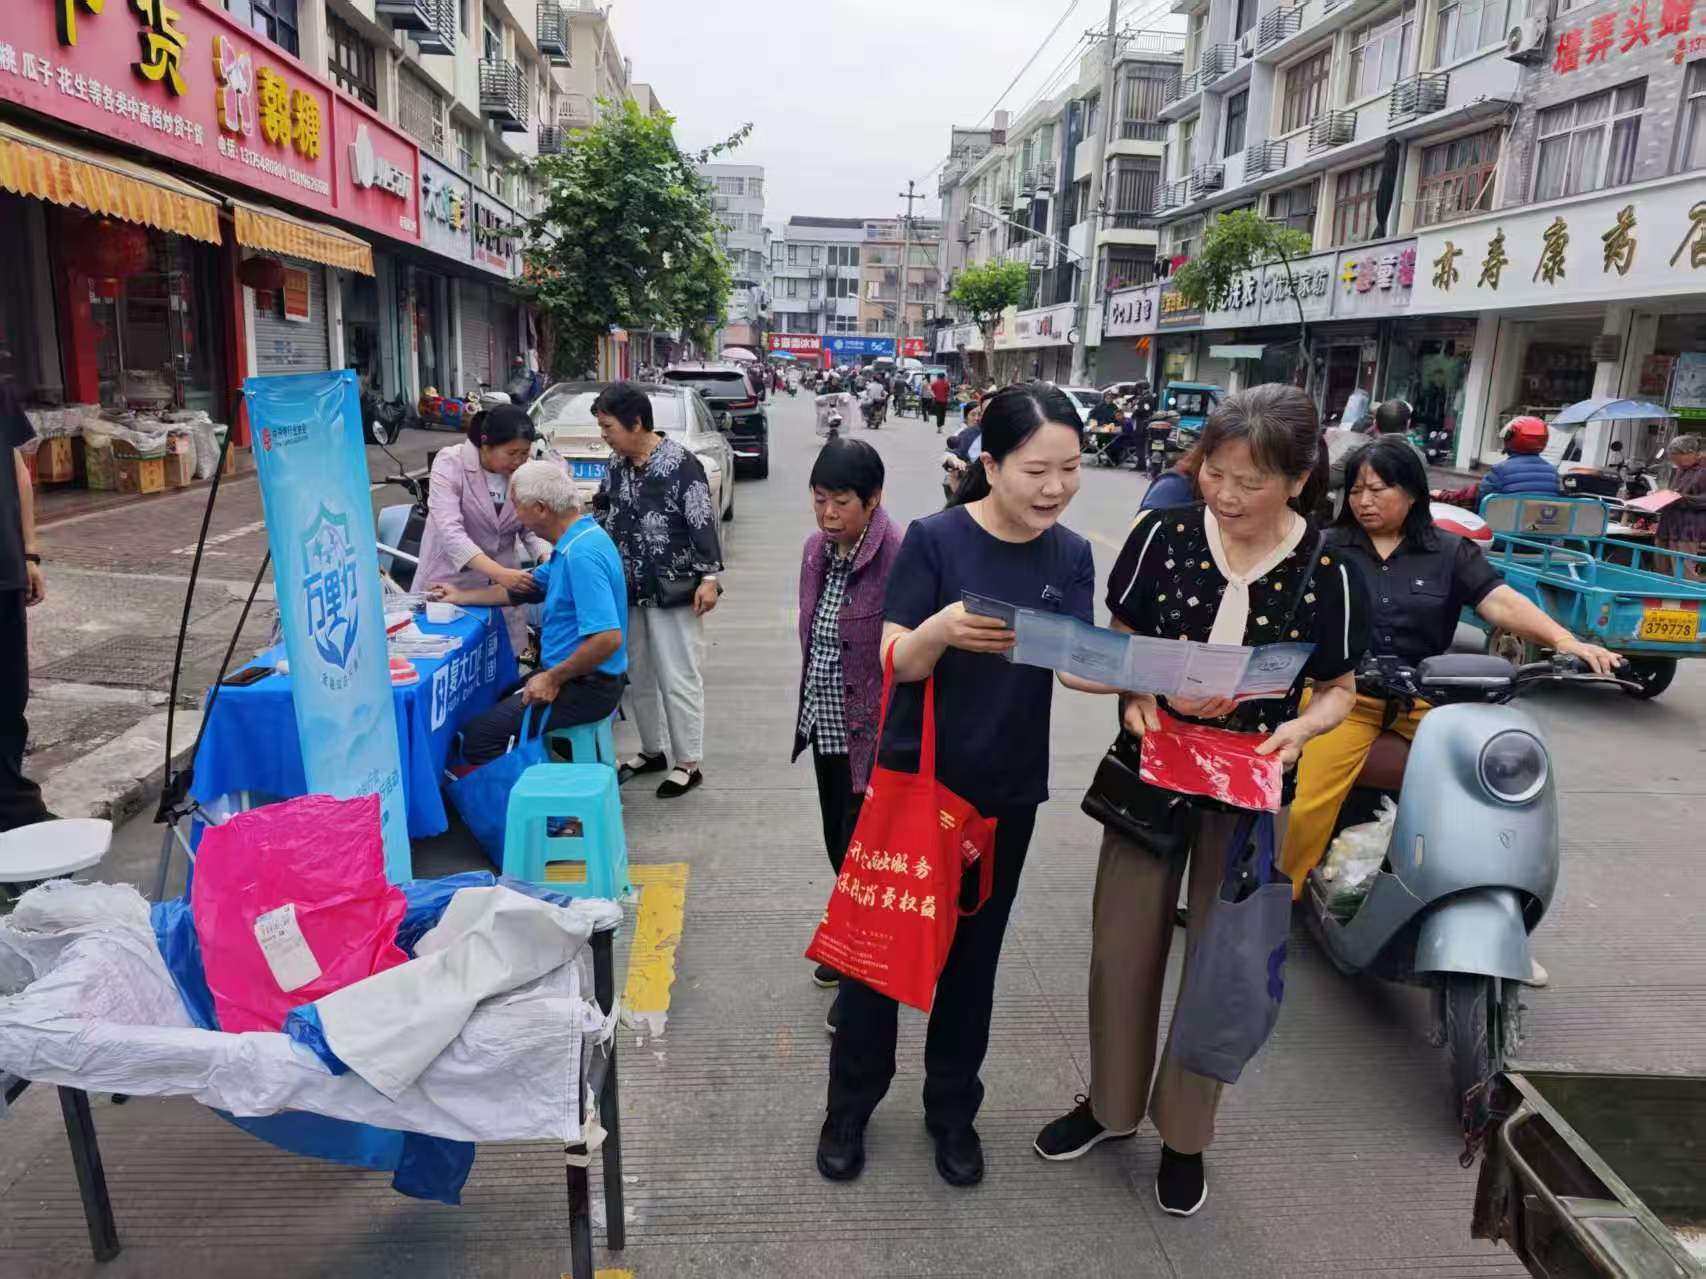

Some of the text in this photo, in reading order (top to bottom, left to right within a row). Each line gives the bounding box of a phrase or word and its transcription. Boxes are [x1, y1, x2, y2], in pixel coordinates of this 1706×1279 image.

[22, 50, 54, 87] 瓜子
[1432, 200, 1706, 292] 亦寿康药店
[1646, 623, 1691, 636] 379778
